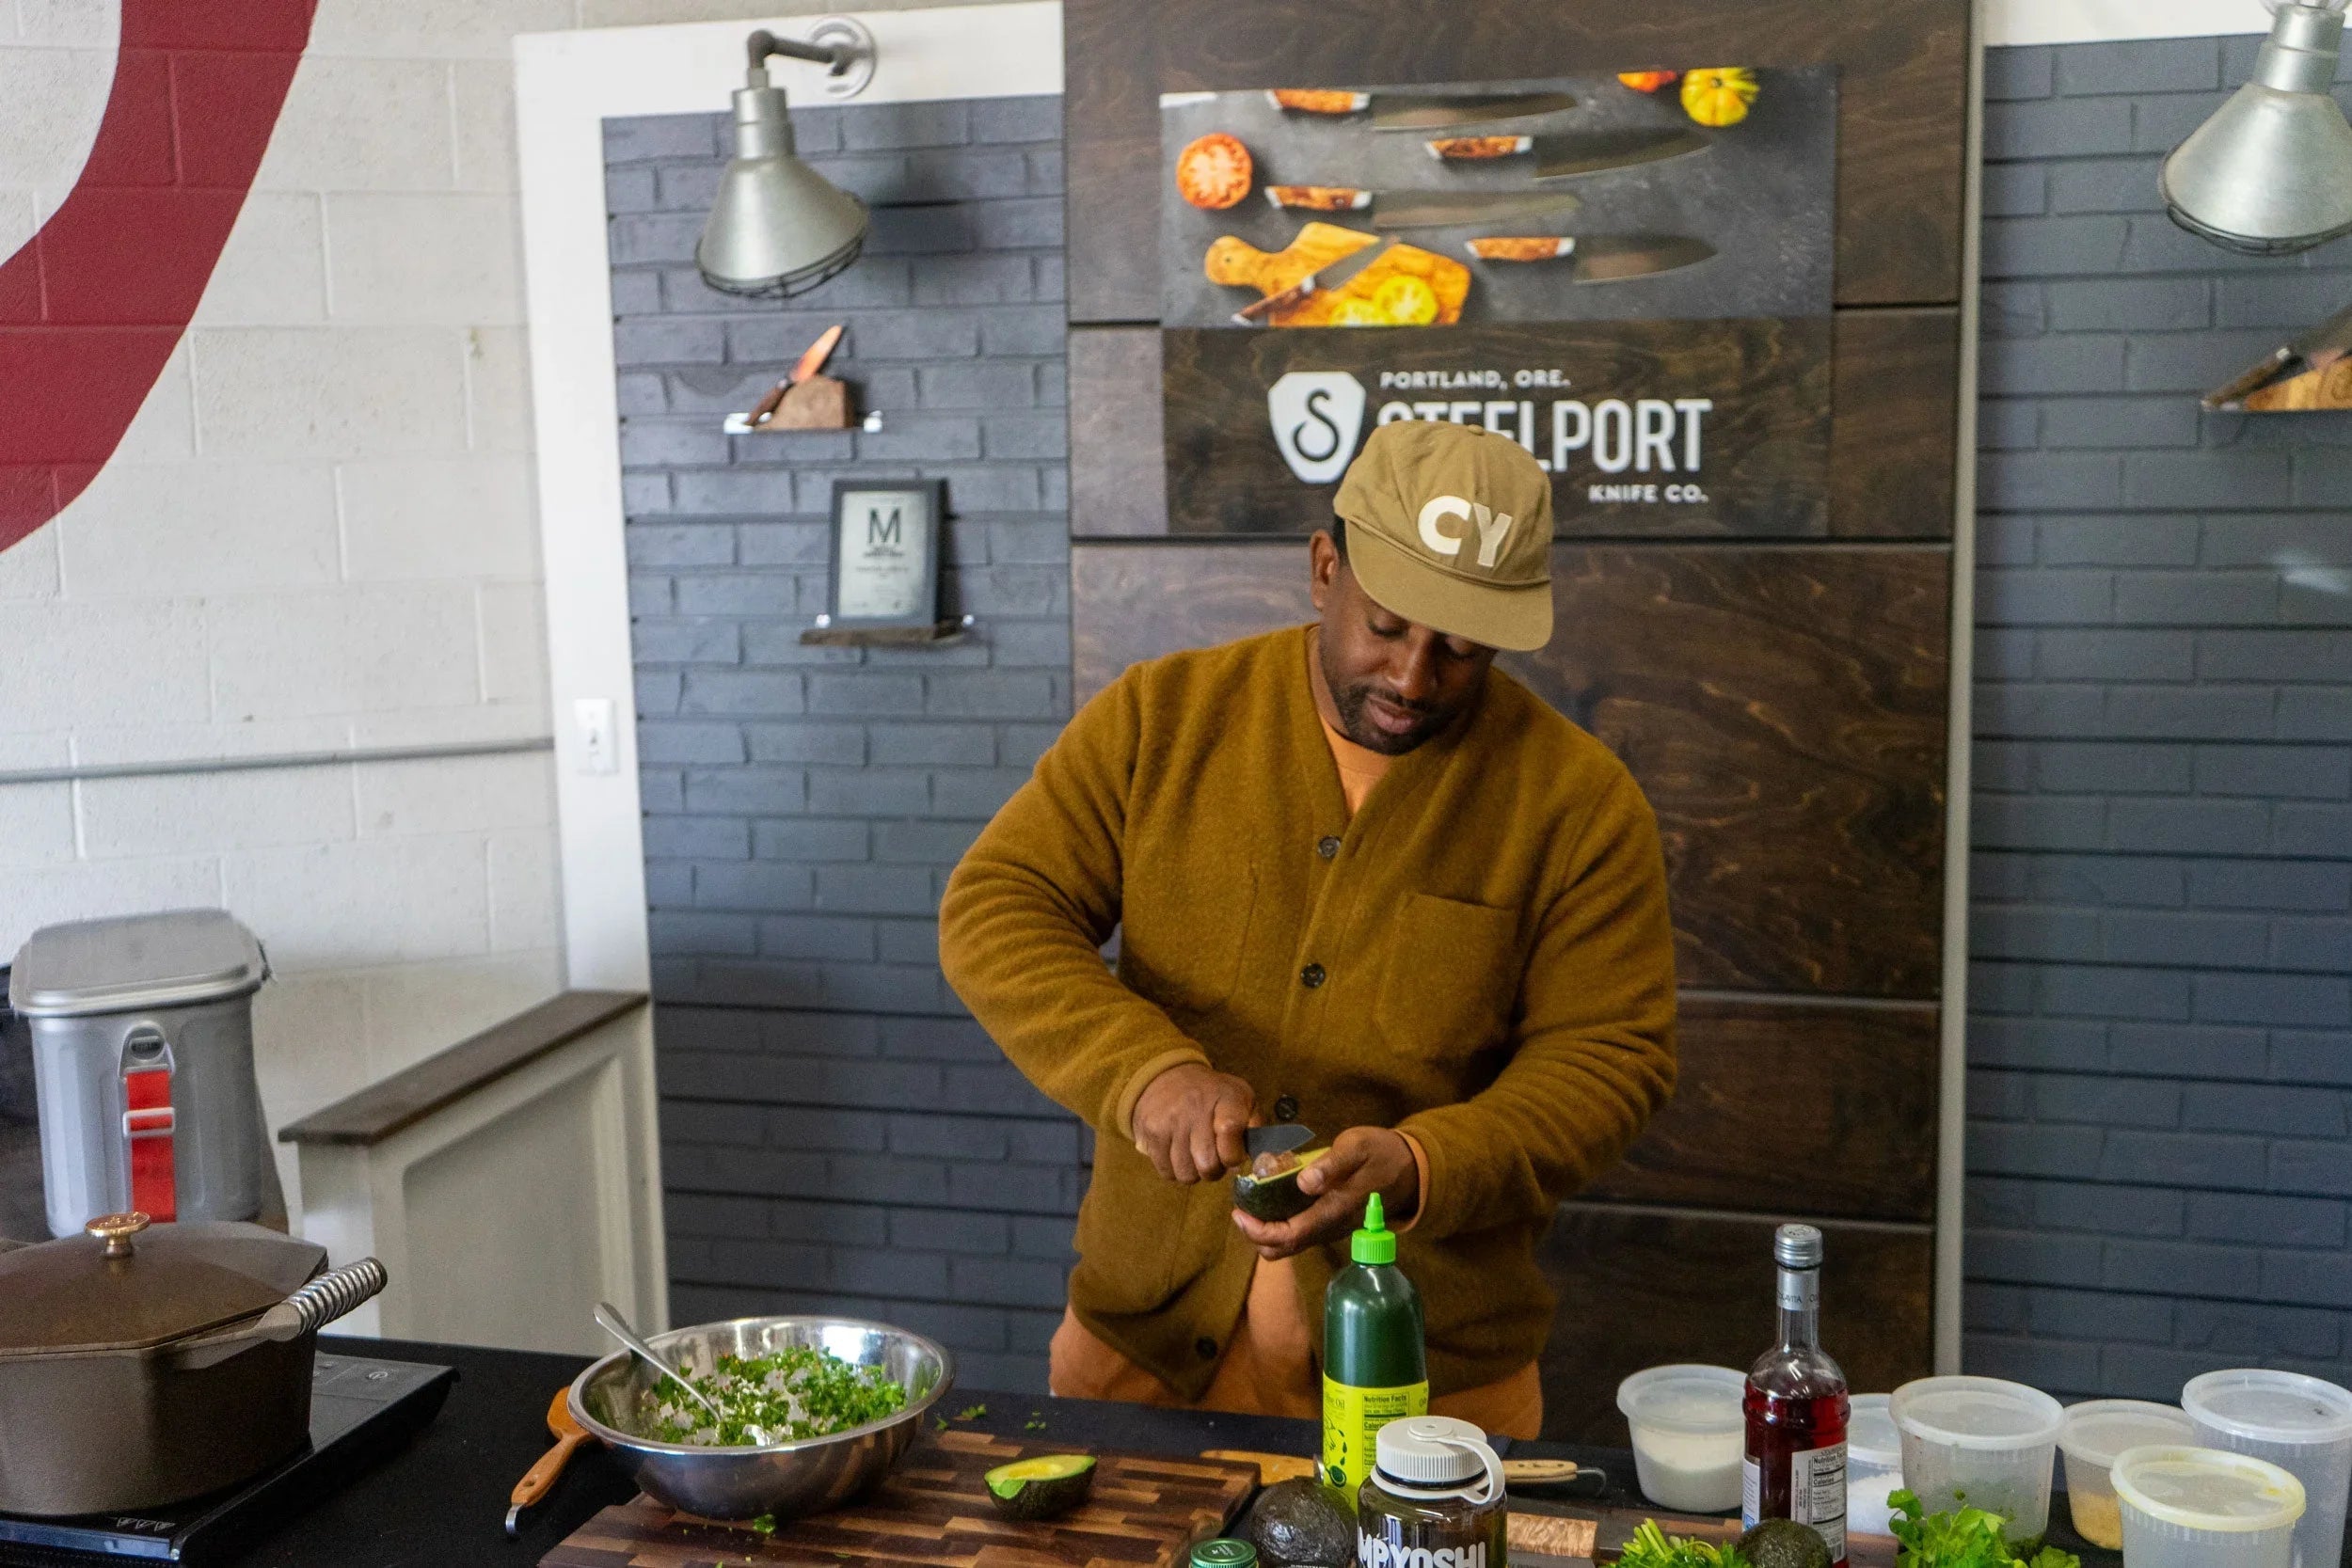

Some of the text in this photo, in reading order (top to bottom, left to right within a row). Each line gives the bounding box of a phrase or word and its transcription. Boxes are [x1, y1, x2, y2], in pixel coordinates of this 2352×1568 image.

[1380, 370, 1571, 390] PORTLAND, ORE.
[1588, 483, 1708, 503] KNIFE CO.
[868, 507, 901, 544] M
[1418, 495, 1512, 567] CY
